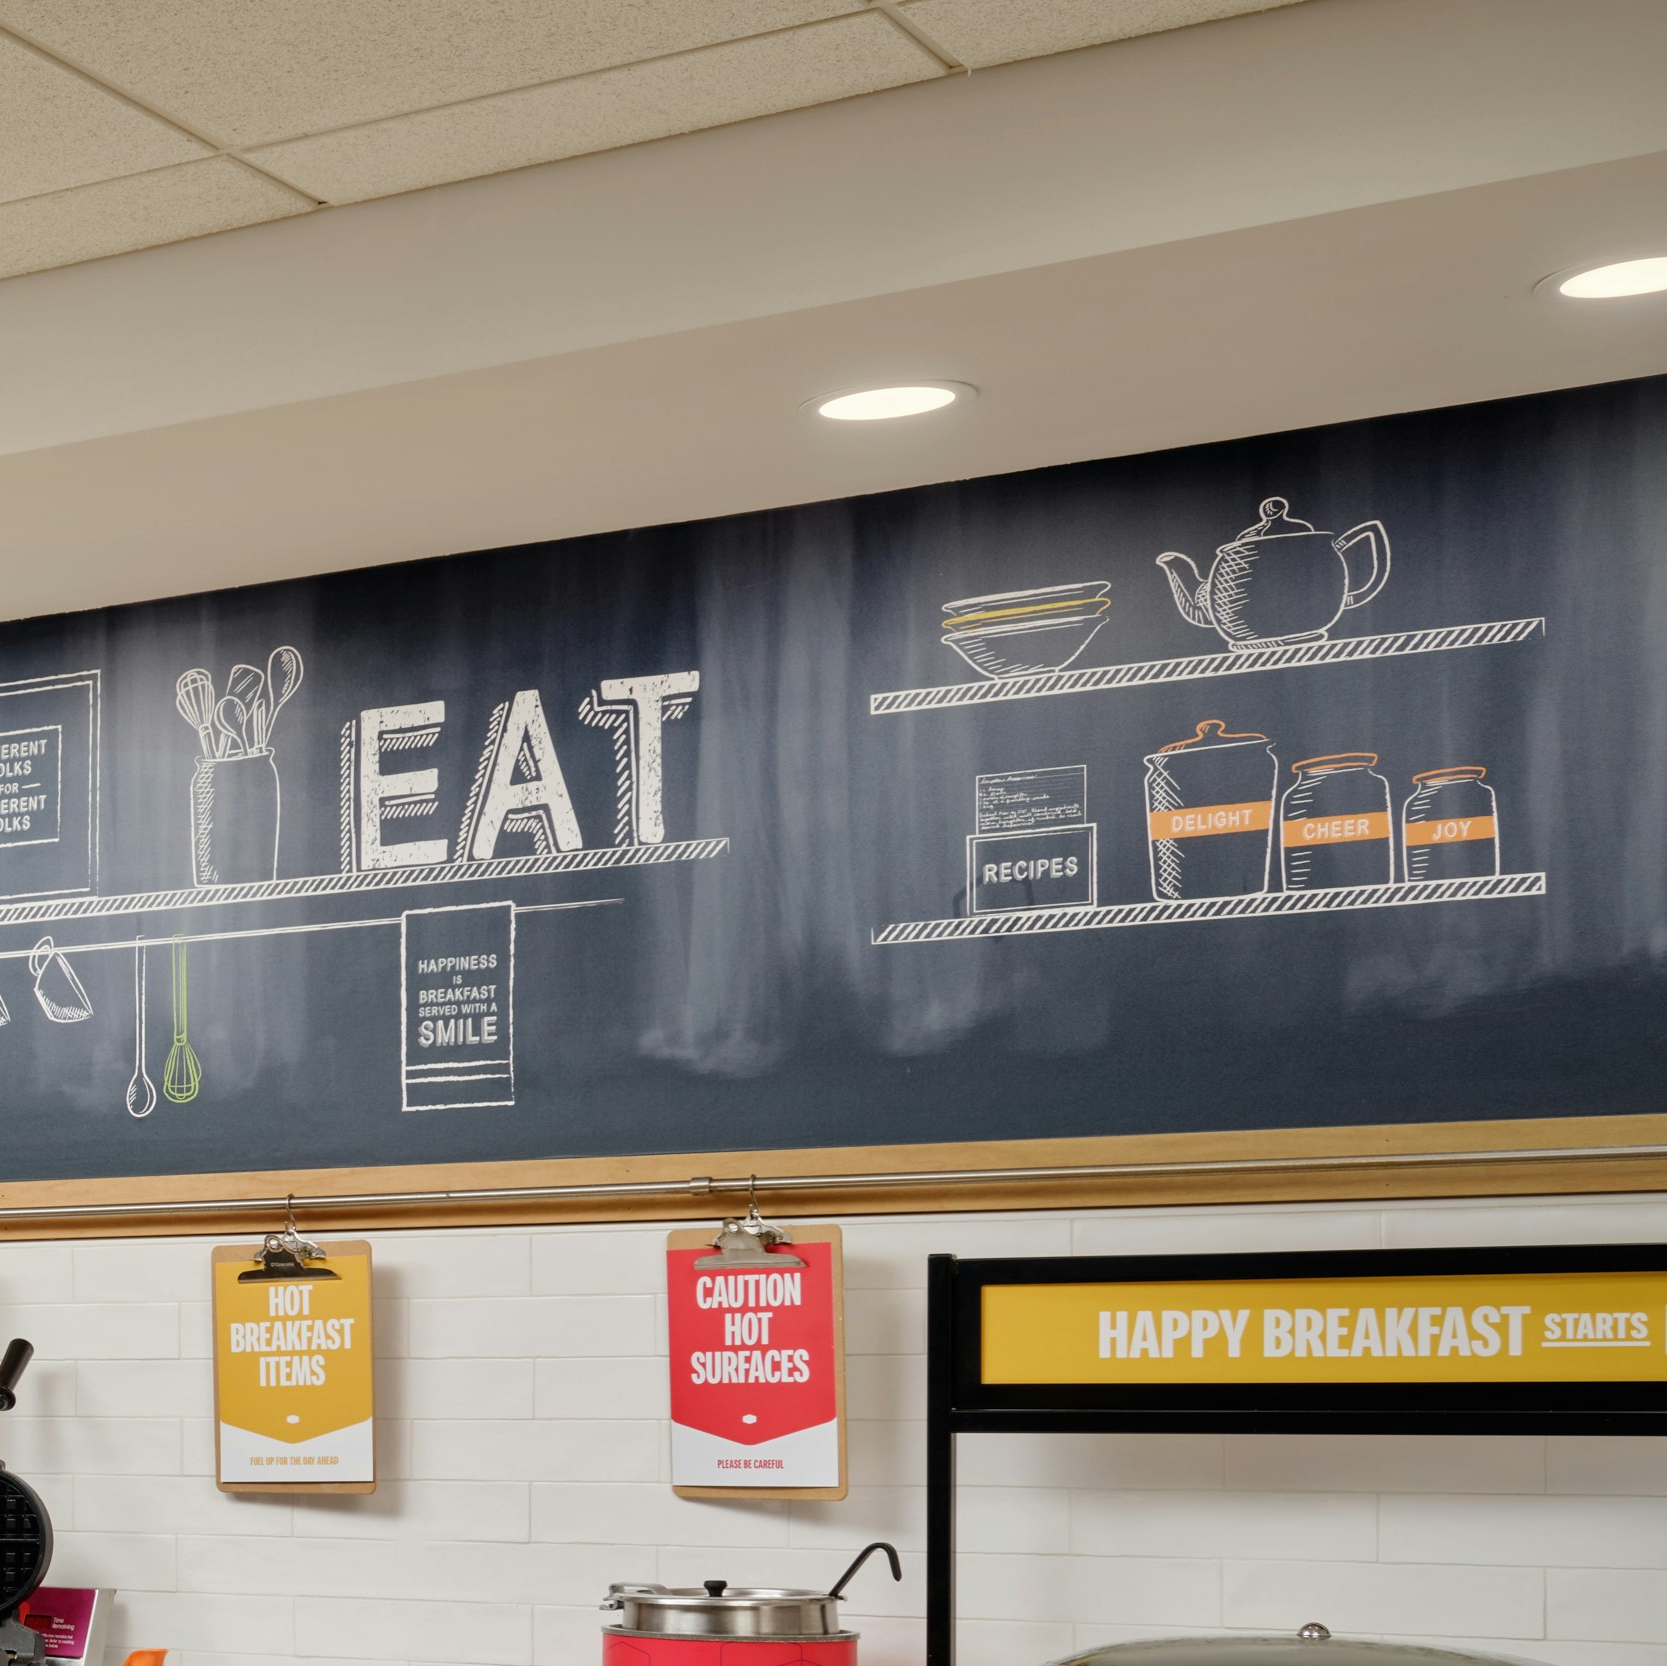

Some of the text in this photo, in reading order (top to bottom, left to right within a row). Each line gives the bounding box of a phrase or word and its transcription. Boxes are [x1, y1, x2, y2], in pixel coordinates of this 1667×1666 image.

[357, 671, 699, 870] EAT
[1171, 809, 1253, 834] DELIGHT
[1302, 820, 1370, 840] CHEER
[1432, 821, 1472, 842] JOY
[983, 857, 1078, 885] RECIPES
[418, 954, 497, 974] HAPPINESS
[453, 975, 462, 984] IS
[419, 985, 497, 1004] BREAKFAST
[419, 1002, 498, 1017] SERVED WITH A
[418, 1016, 498, 1047] SMILE
[268, 1284, 313, 1317] HOT
[696, 1272, 802, 1309] CAUTION
[230, 1318, 355, 1353] BREAKFAST
[724, 1312, 773, 1346] HOT
[1098, 1305, 1649, 1359] HAPPY BREAKFAST STARTS
[259, 1355, 326, 1387] ITEMS
[690, 1349, 810, 1384] SURFACES
[250, 1456, 339, 1466] FUEL UP FOR THE DAY AHEAD
[717, 1459, 785, 1469] PLEASE BE CAREFUL
